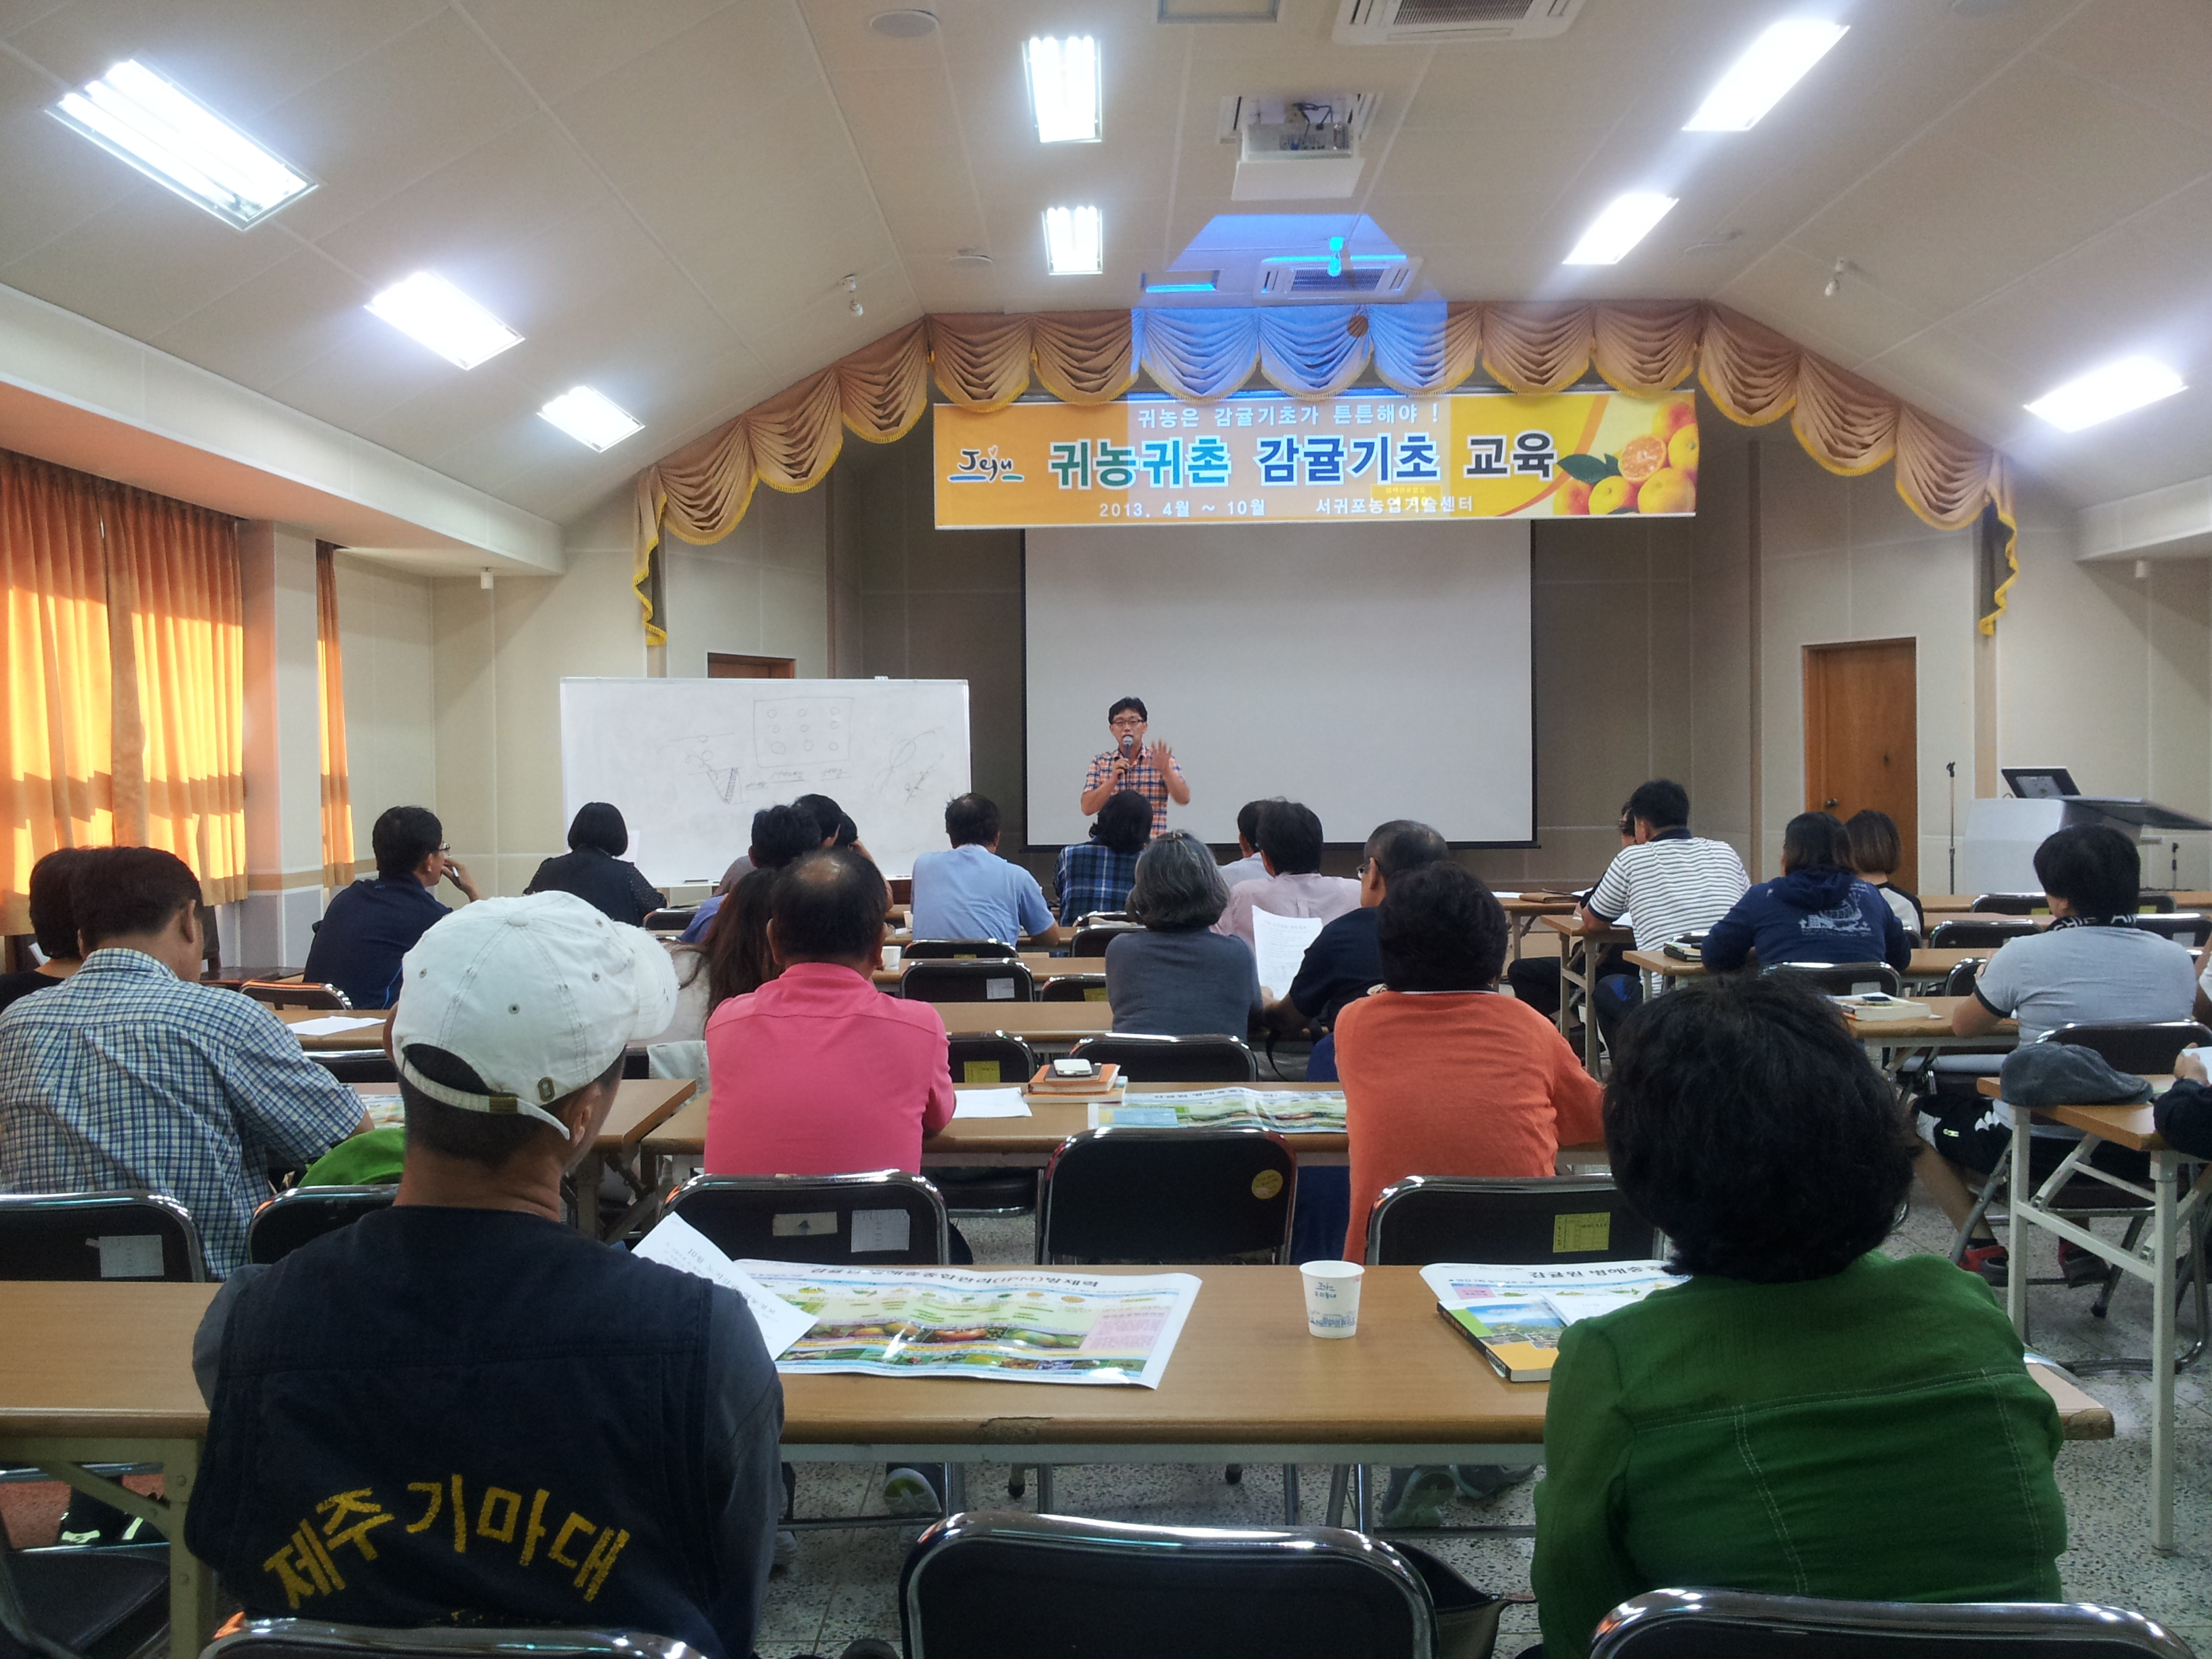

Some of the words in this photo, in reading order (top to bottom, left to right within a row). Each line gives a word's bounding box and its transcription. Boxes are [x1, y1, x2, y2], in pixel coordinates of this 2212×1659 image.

[1139, 407, 1200, 428] 귀농은
[1214, 405, 1319, 427] 감귤기초가
[1334, 403, 1418, 424] 튼튼해야
[958, 445, 1013, 482] Jeju
[1048, 436, 1231, 491] 귀농귀촌
[1253, 431, 1441, 487] 감귤기초
[1463, 430, 1557, 481] 교육
[1099, 502, 1150, 518] 2013.
[1163, 500, 1189, 517] 4월
[1227, 498, 1265, 516] 10월
[1315, 495, 1473, 514] 서귀포농업기술센터
[263, 1474, 630, 1610] 제주기마대
